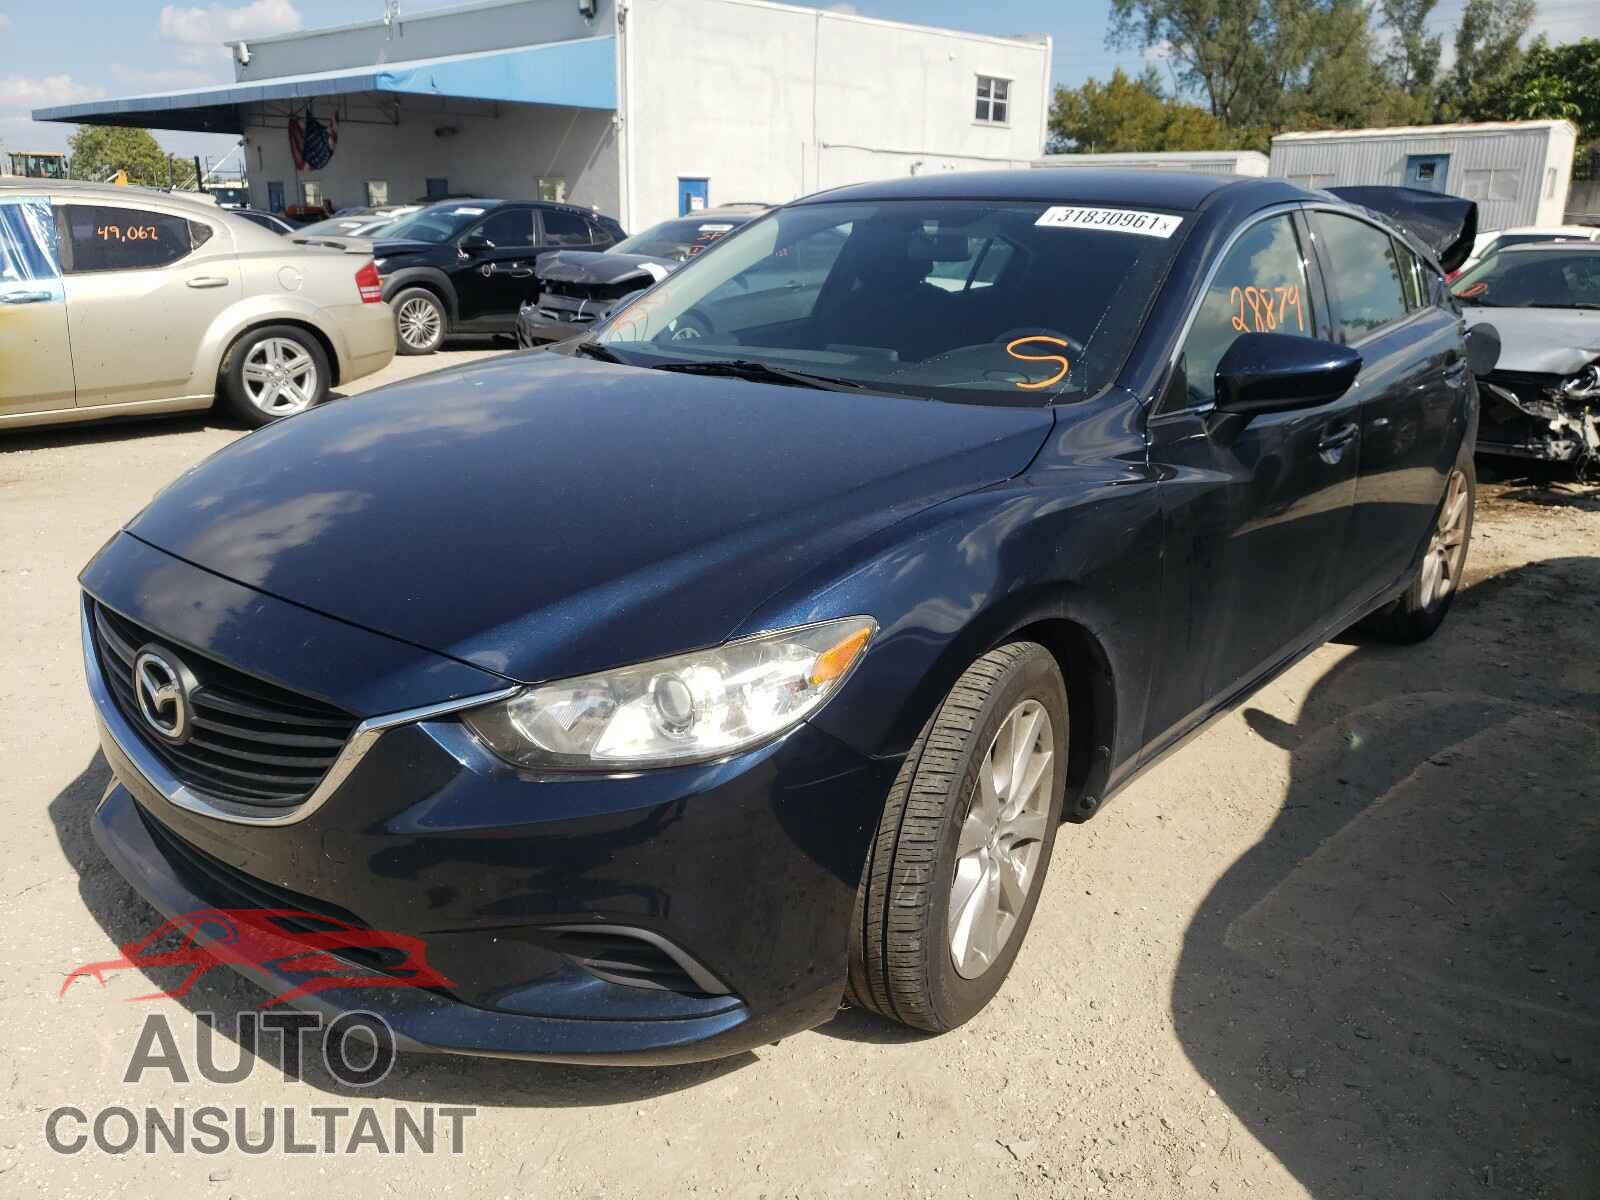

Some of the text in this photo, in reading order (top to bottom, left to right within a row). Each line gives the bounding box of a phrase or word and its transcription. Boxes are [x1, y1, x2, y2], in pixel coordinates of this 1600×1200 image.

[97, 224, 158, 243] 49,062
[1057, 208, 1160, 230] 31830961
[1231, 286, 1303, 333] 28879
[1006, 335, 1069, 390] S
